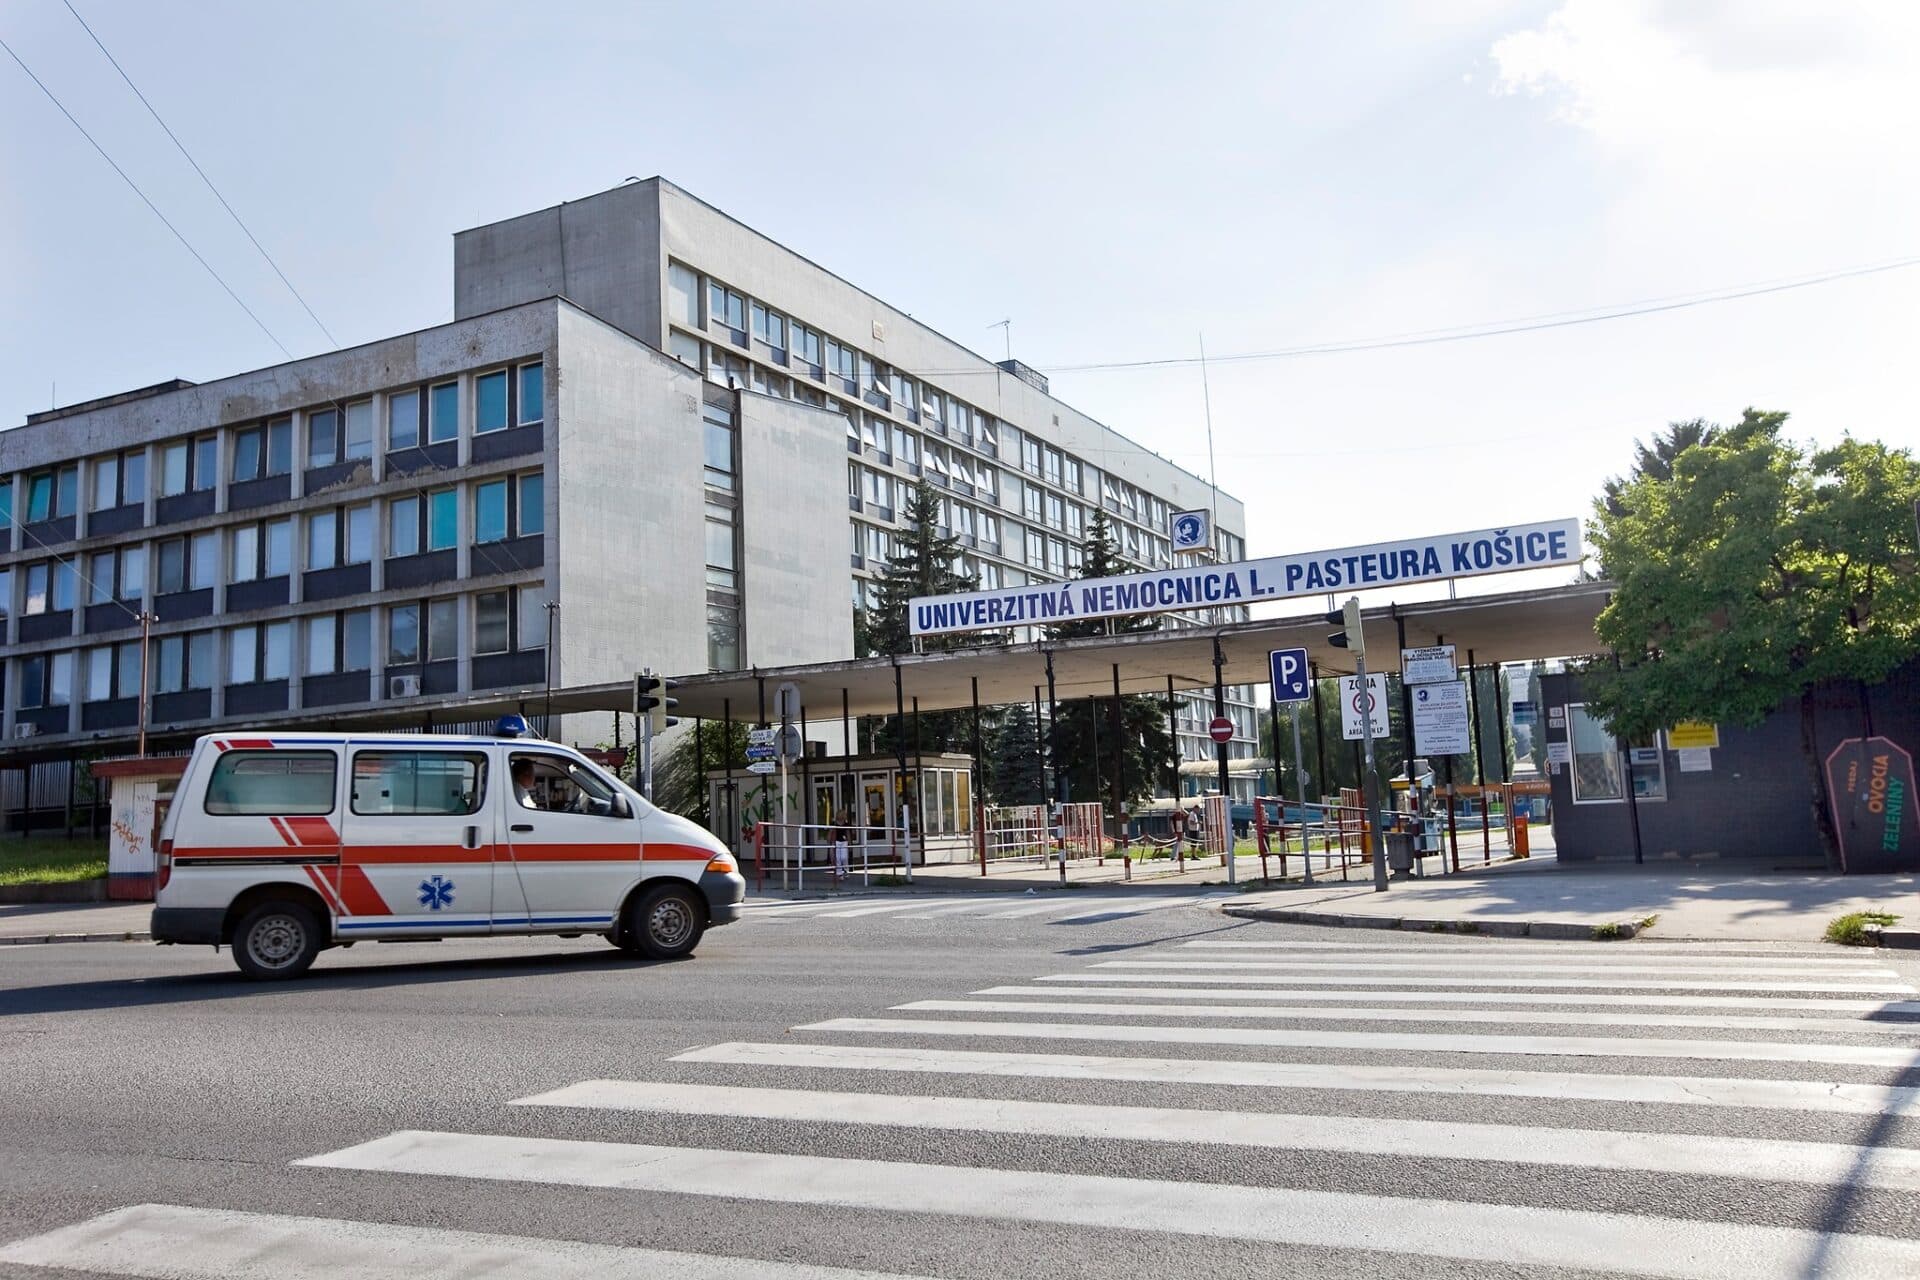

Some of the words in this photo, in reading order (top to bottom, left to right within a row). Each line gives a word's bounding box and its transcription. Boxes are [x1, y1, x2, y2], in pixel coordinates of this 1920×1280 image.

[918, 583, 1075, 630] UNIVERZITNÁ
[1082, 571, 1242, 614] NEMOCNICA
[1249, 569, 1275, 595] L.
[1286, 546, 1442, 592] PASTEURA
[1451, 529, 1568, 572] KOŠICE
[1280, 655, 1298, 685] P
[1868, 754, 1889, 814] OVOCIA
[1883, 775, 1904, 851] ZELENINY
